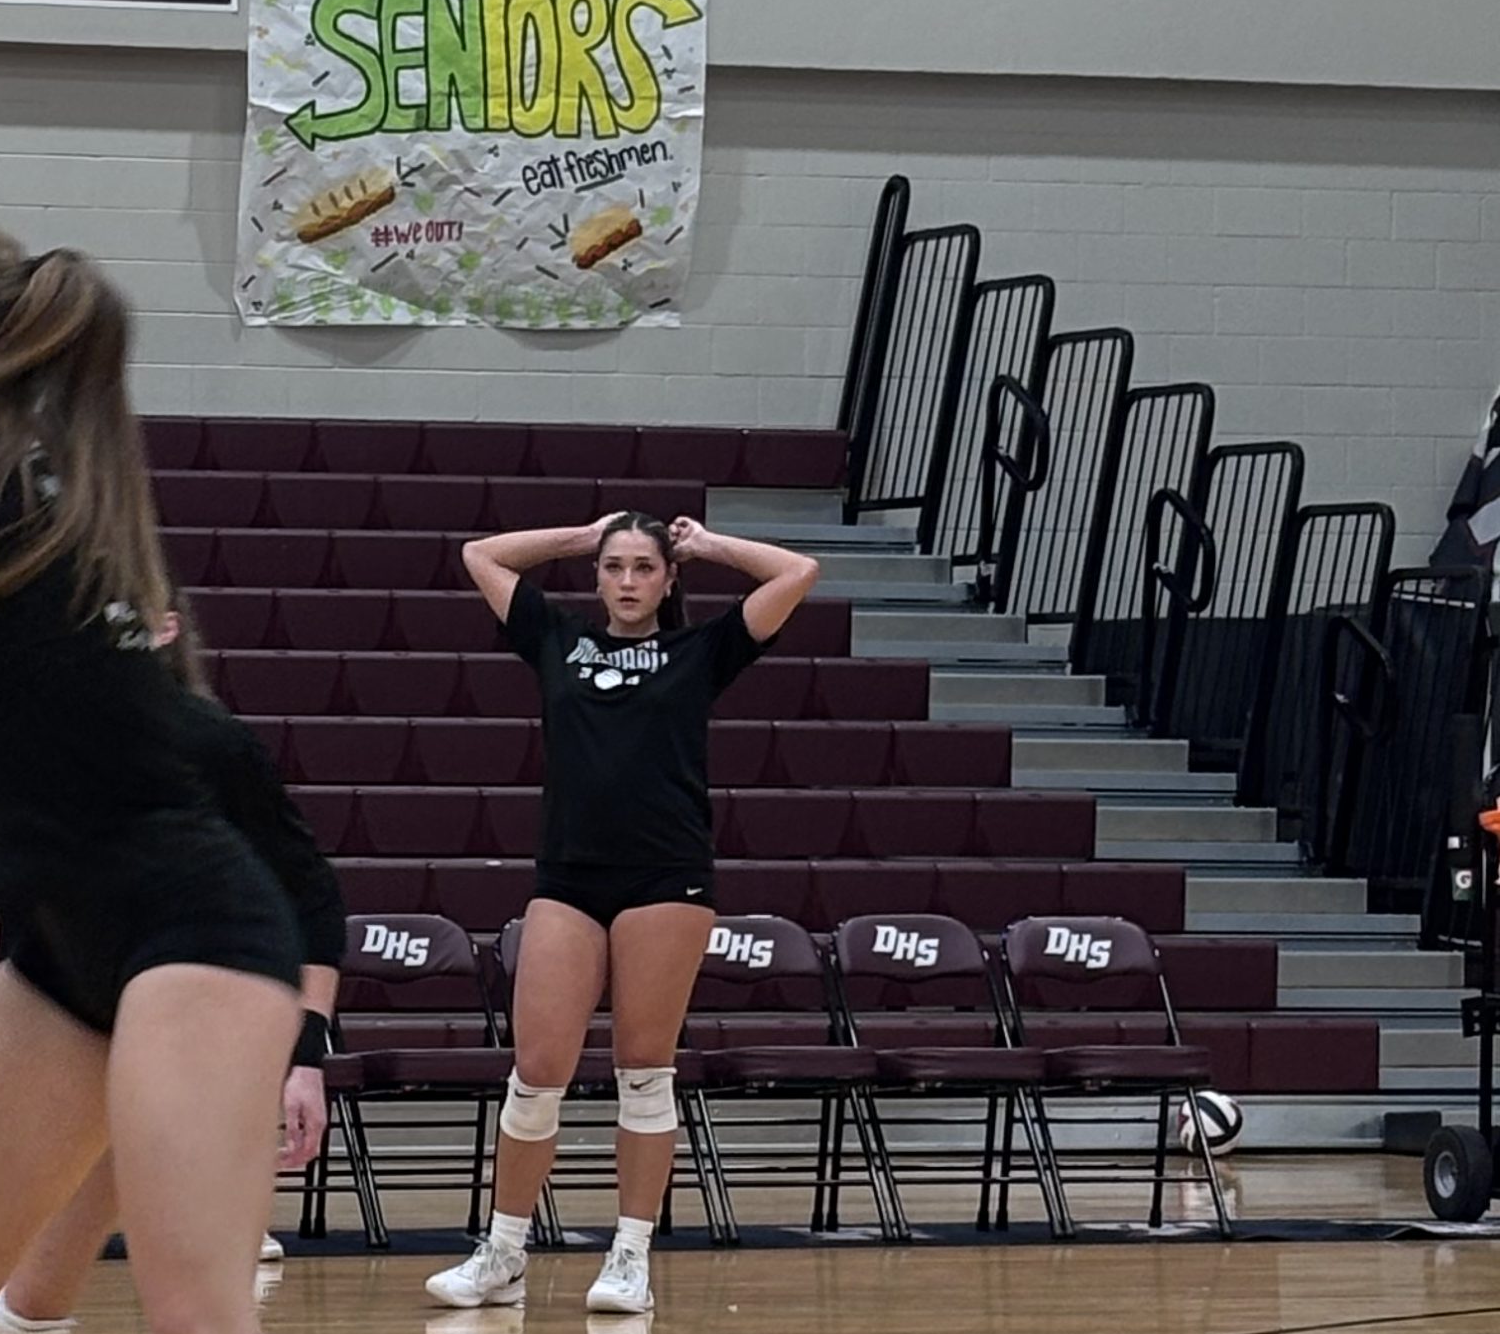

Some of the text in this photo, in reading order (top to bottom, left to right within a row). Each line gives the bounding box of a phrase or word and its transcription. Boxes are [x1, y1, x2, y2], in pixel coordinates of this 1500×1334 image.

[521, 154, 565, 196] eat
[1455, 870, 1472, 889] G
[360, 924, 430, 967] DHS
[705, 926, 775, 968] DHS
[872, 925, 940, 967] DHS
[1043, 926, 1113, 969] DHS
